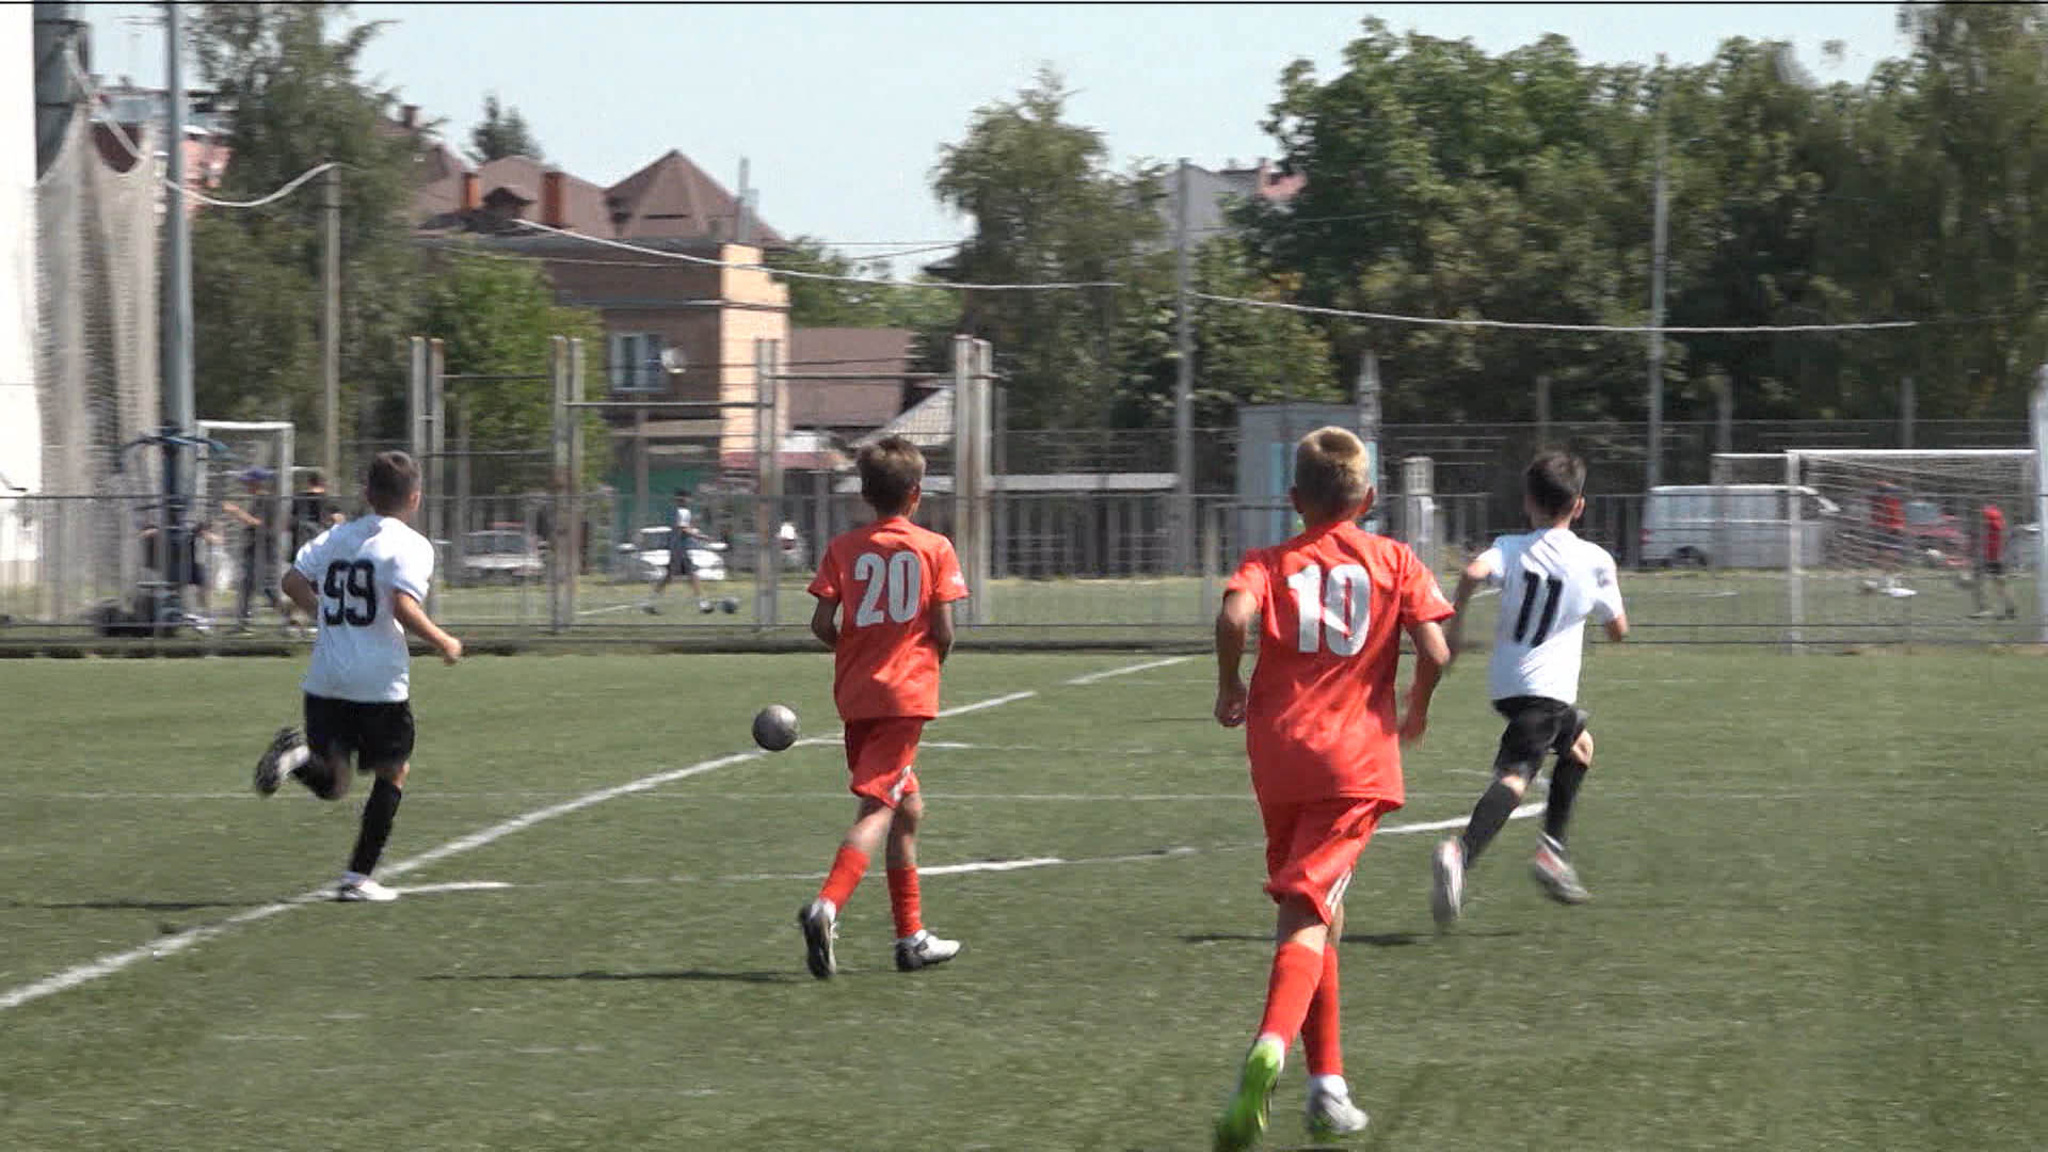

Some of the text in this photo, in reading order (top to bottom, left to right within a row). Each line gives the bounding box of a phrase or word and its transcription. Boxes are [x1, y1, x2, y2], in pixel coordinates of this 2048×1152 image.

[324, 559, 376, 626] 99
[854, 551, 921, 627] 20
[1287, 564, 1370, 656] 10
[1514, 570, 1563, 648] 11
